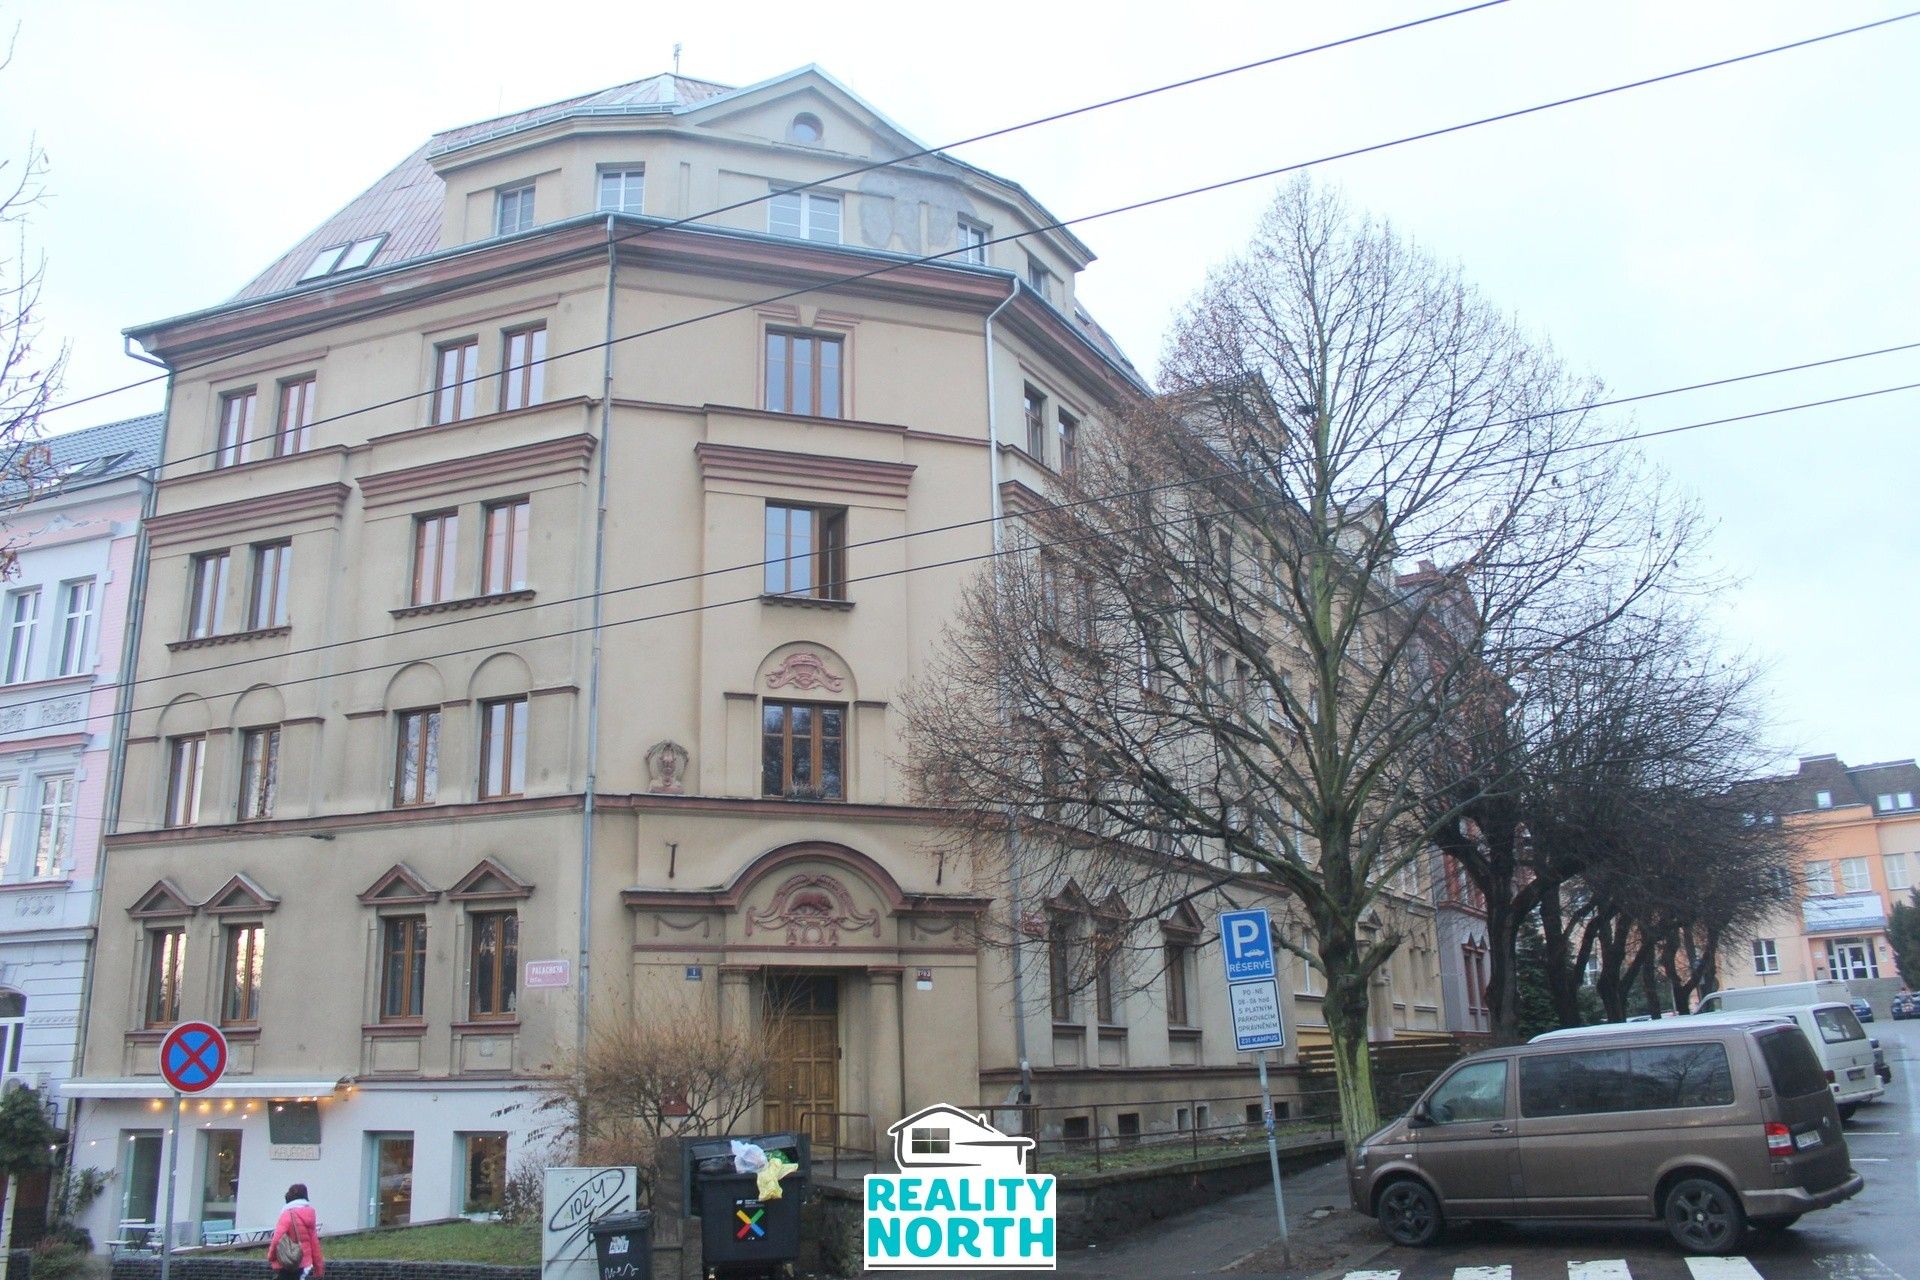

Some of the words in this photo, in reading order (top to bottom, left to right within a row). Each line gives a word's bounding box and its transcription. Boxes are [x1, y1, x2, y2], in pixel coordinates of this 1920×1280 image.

[1231, 919, 1259, 959] P
[1229, 959, 1271, 973] RÉSERVÉ
[1252, 1034, 1279, 1044] KAMPUS
